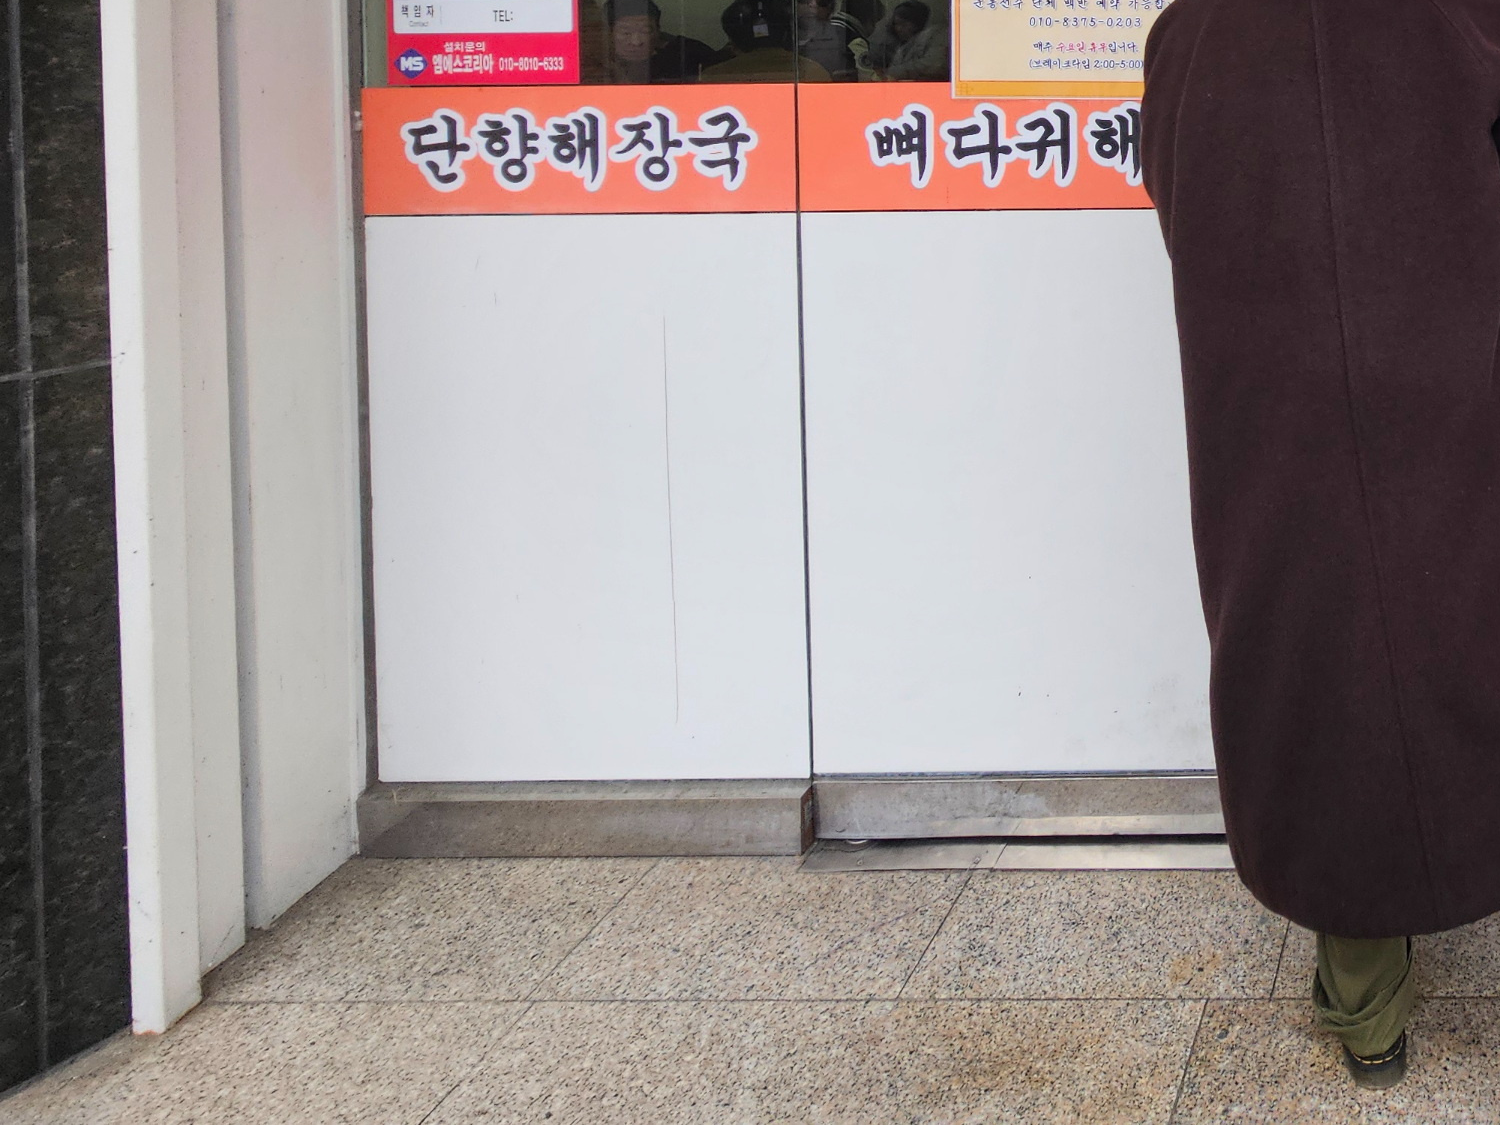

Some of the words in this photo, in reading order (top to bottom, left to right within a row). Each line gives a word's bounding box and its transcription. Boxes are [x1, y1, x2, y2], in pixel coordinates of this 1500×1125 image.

[492, 9, 514, 23] TEL:
[1029, 16, 1143, 28] 010-8375-0203
[443, 41, 486, 53] 설치문의
[1033, 41, 1053, 53] 매주
[1056, 41, 1085, 53] 수요일
[400, 58, 424, 71] MS
[432, 53, 495, 75] 엠에스코리아
[499, 56, 564, 71] 010-8010-6333
[403, 107, 758, 191] 단향해장국
[870, 106, 1142, 186] 뼈다귀해
